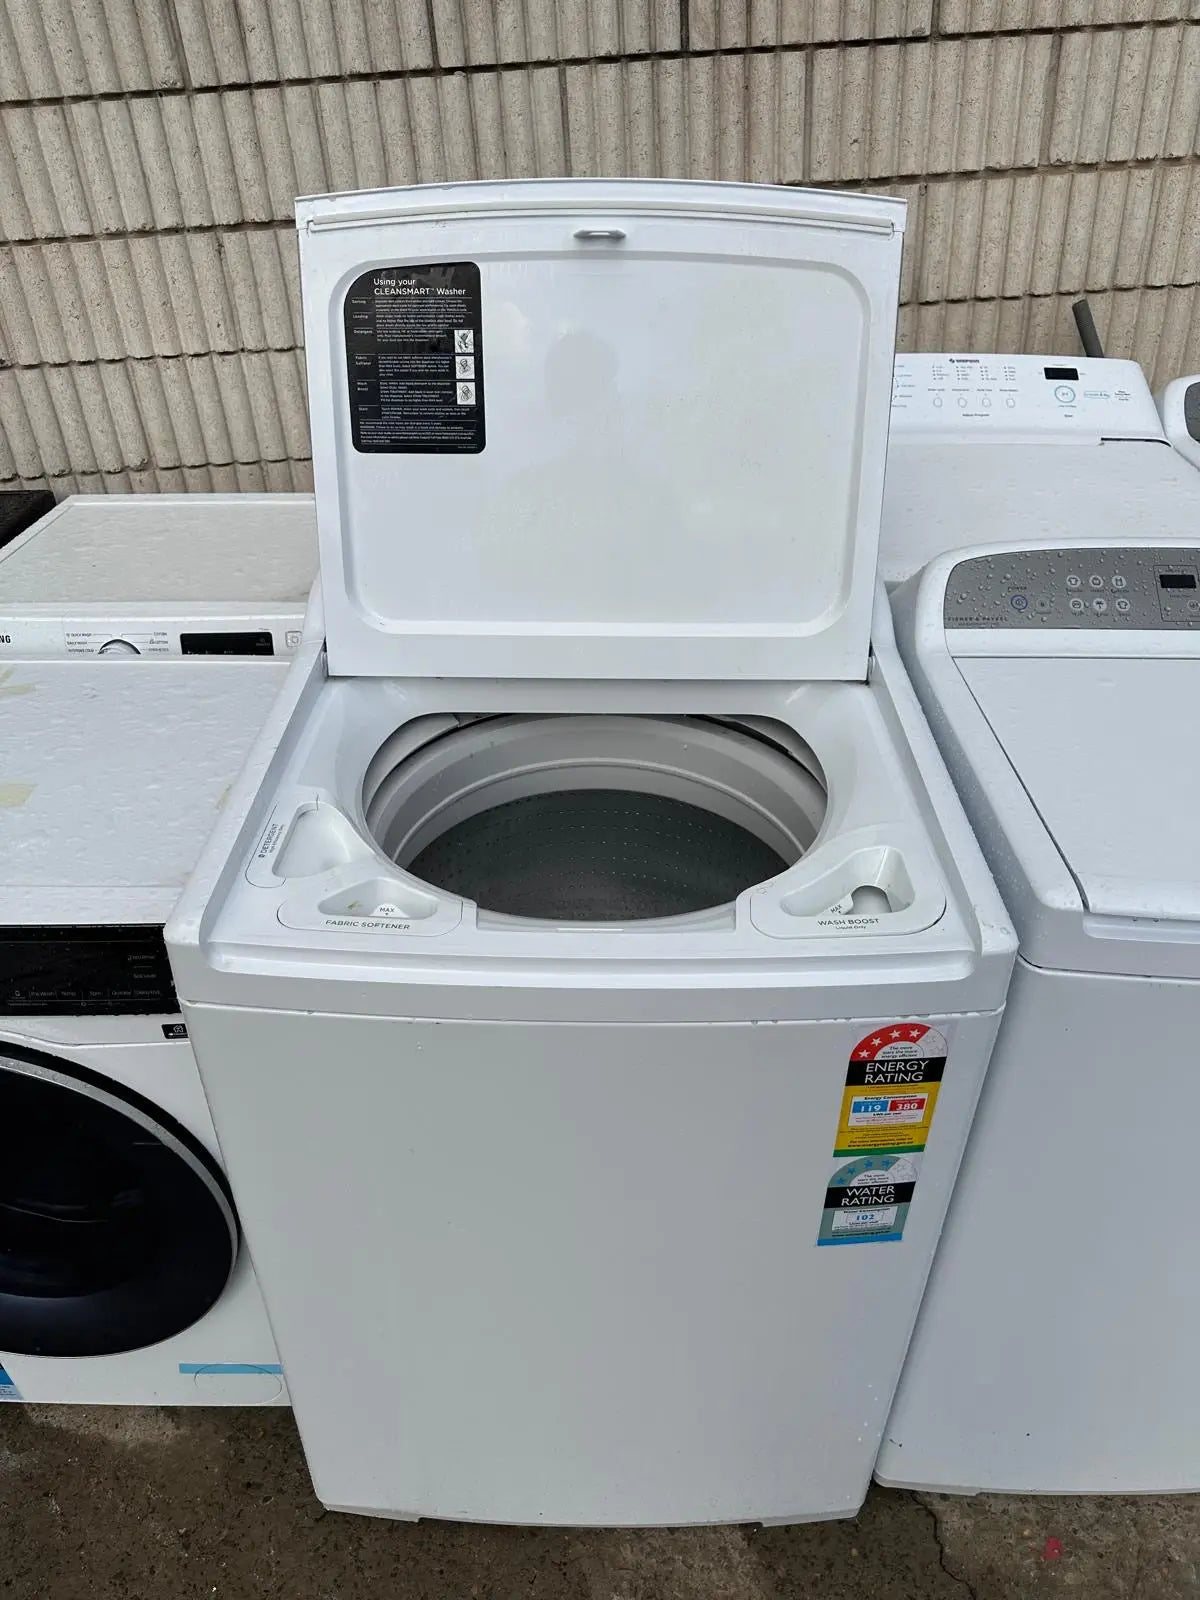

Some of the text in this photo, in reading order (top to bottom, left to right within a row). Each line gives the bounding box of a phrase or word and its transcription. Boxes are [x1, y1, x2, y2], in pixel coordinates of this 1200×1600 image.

[373, 278, 396, 286] Using
[261, 824, 279, 853] DETERGENT
[830, 904, 843, 914] MAX
[361, 921, 410, 930] SOFTENER
[866, 1060, 929, 1072] ENERGY
[864, 1072, 923, 1083] RATING
[846, 1186, 895, 1196] WATER
[841, 1195, 894, 1206] RATING
